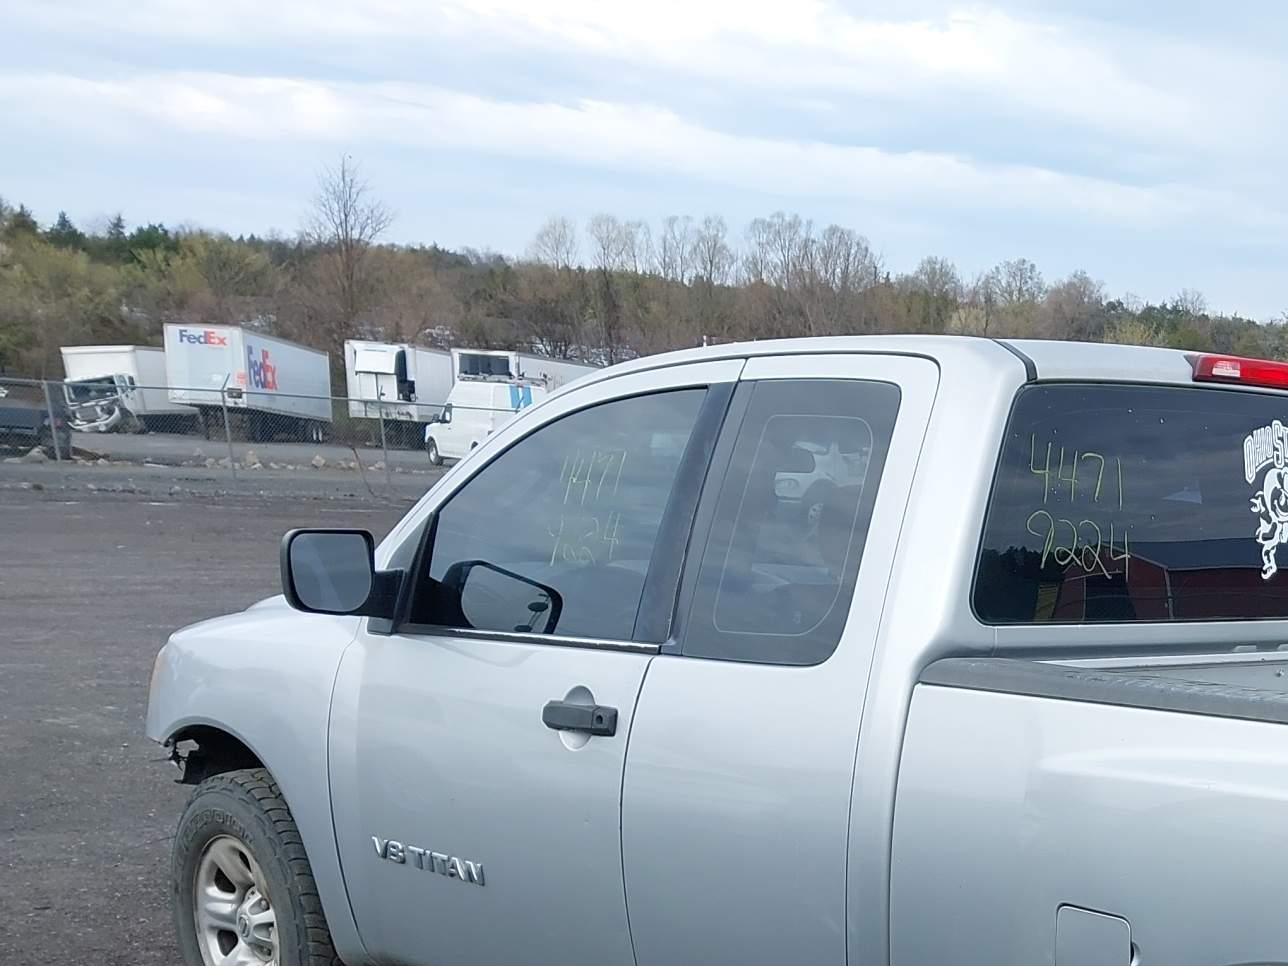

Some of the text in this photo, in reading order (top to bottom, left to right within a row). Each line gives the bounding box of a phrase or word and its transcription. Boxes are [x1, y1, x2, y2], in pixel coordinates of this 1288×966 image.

[179, 329, 227, 345] FedEx
[247, 344, 278, 391] FedEx
[1030, 432, 1123, 512] 4471
[1244, 426, 1273, 484] OHIO
[1026, 510, 1131, 583] 9224
[371, 836, 485, 887] V8 TITAN
